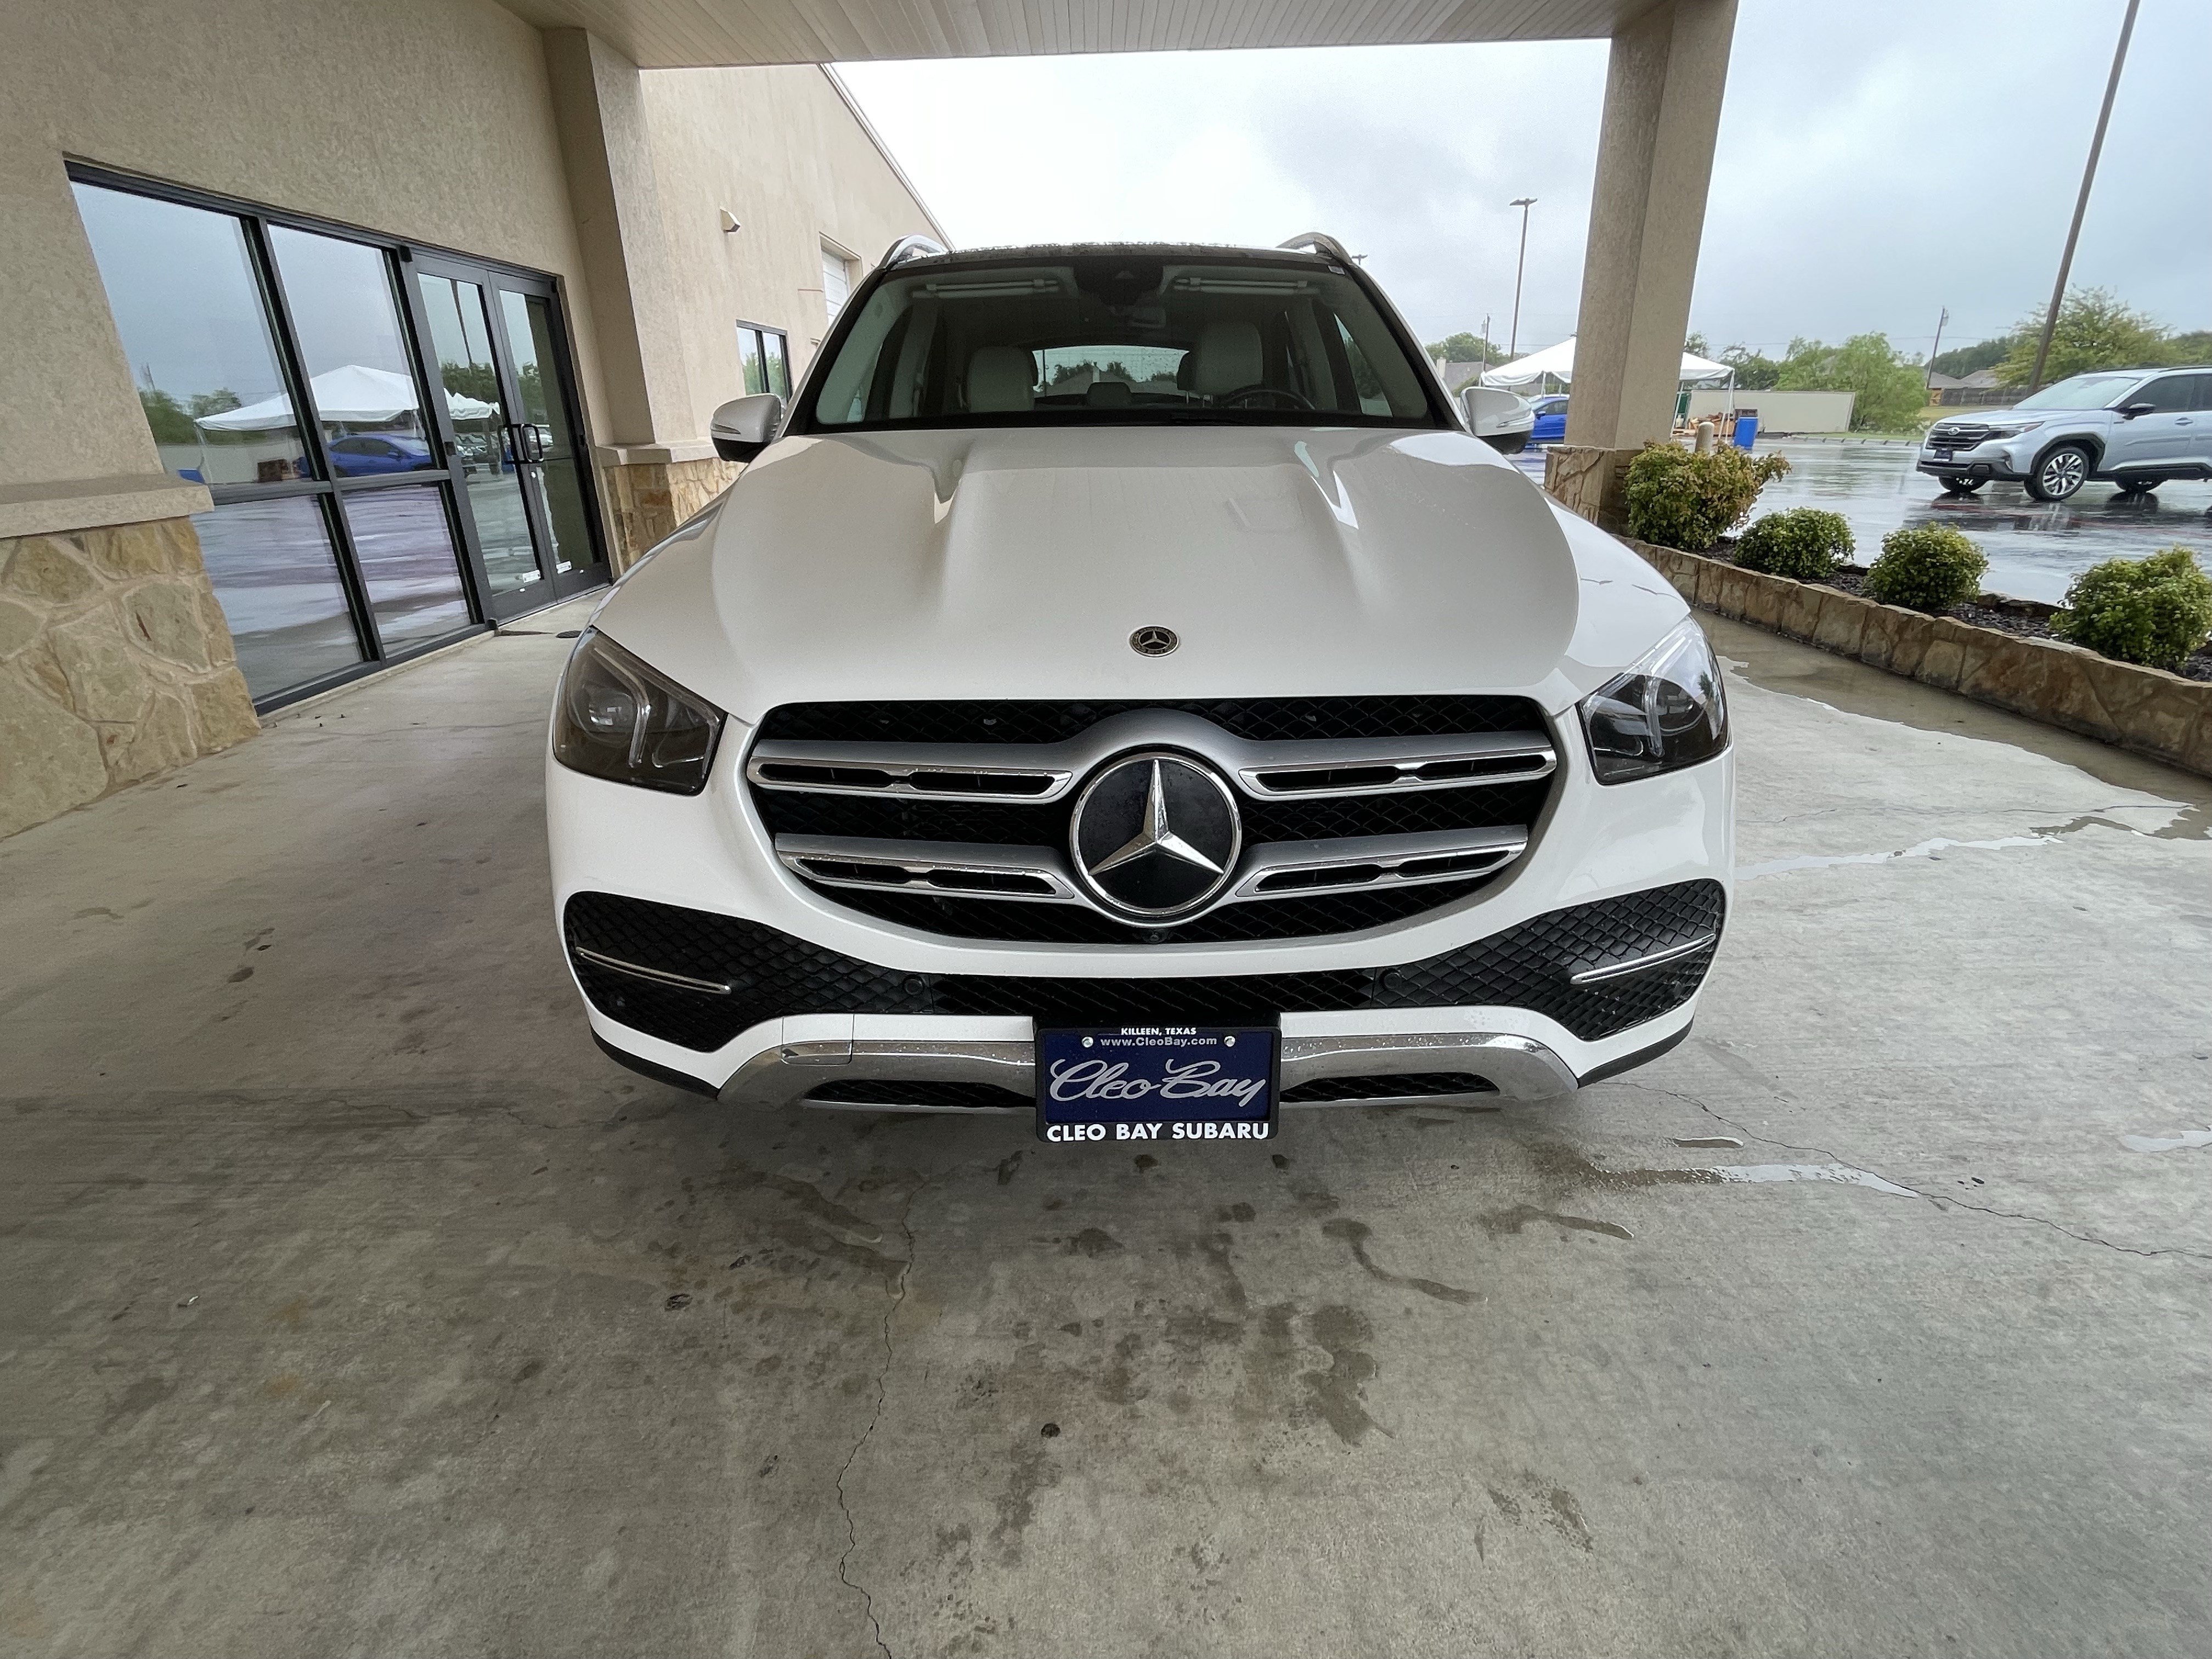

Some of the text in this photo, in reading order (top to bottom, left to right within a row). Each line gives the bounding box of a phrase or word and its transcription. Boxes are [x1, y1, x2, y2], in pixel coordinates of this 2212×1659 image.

[1121, 1027, 1197, 1036] KILLEEN, TEXAS
[1101, 1036, 1217, 1047] www.CleoBay.com
[1050, 1059, 1266, 1107] Cleo Bay
[1046, 1123, 1269, 1142] CLEO BAY SUBARU
